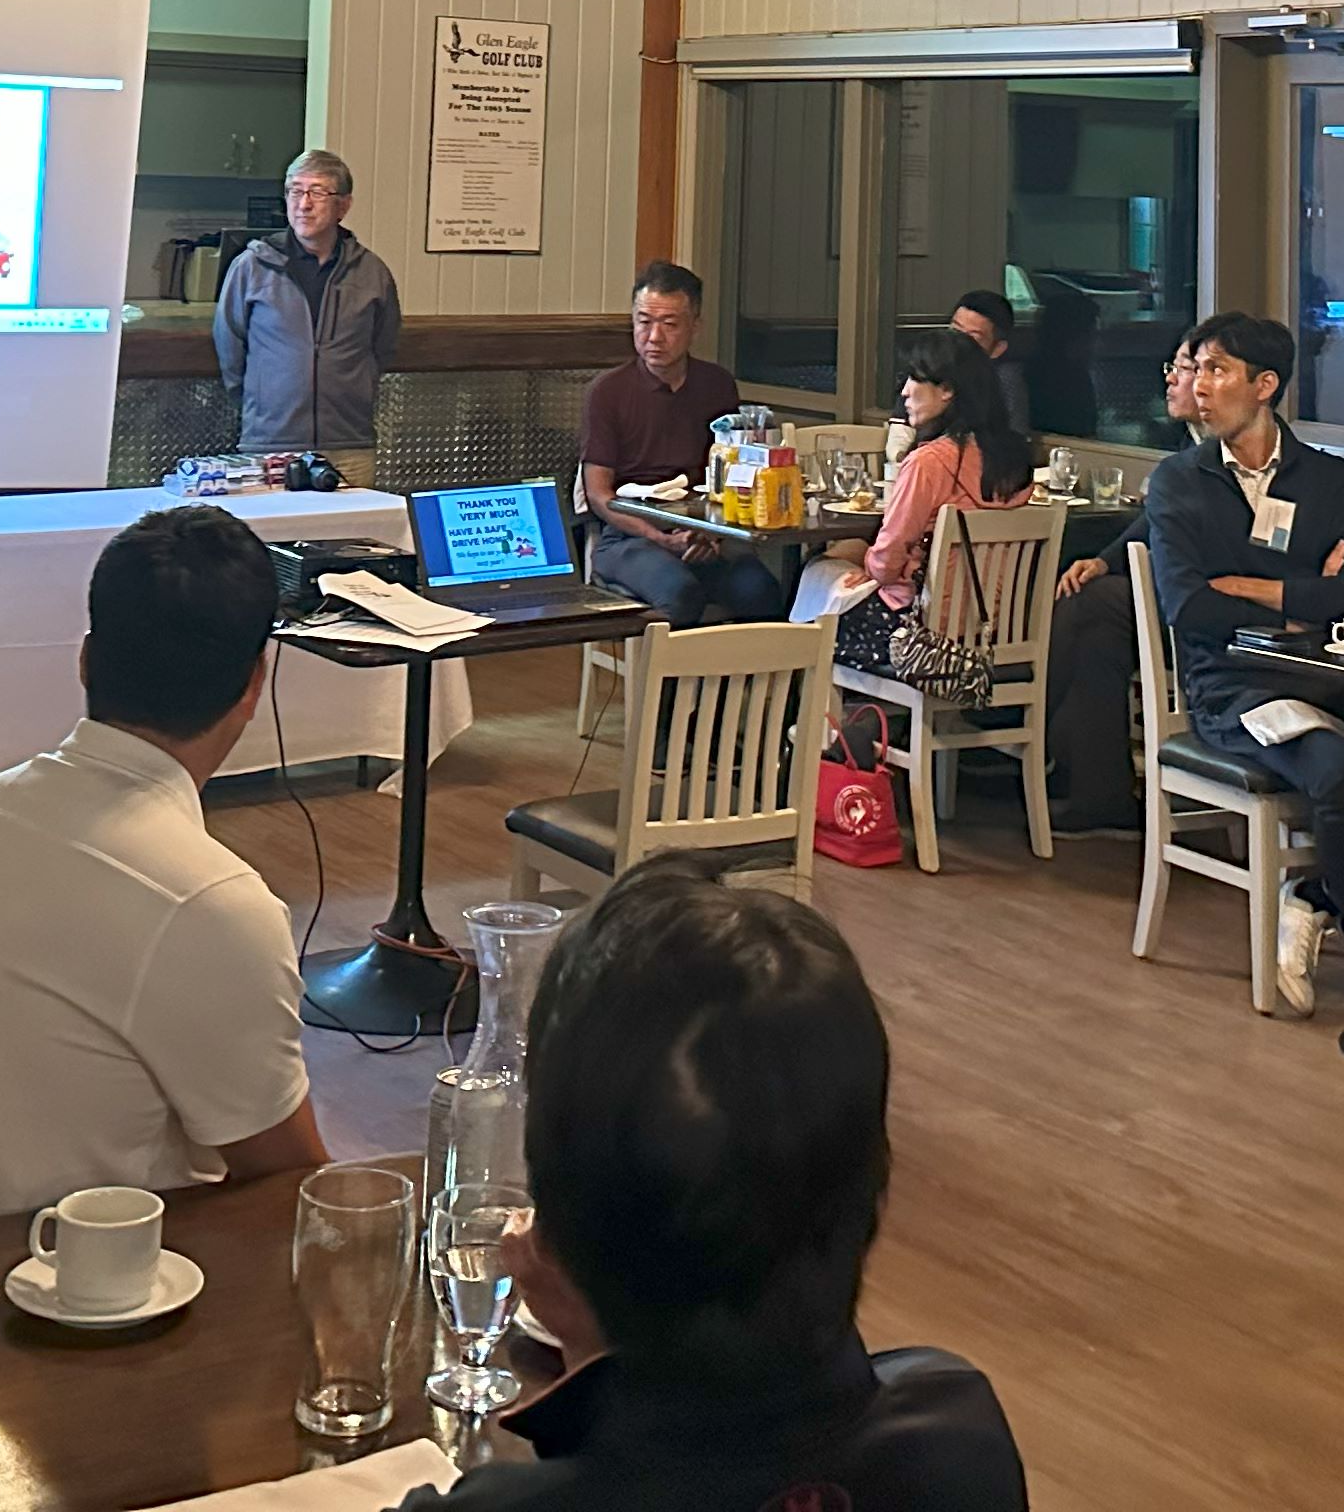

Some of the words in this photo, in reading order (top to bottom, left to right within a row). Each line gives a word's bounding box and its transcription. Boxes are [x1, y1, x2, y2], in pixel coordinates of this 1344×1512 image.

[476, 33, 503, 47] Glen
[506, 35, 538, 50] Eagle
[481, 51, 511, 66] GOLF
[513, 53, 543, 68] CLUB
[456, 499, 493, 509] THANK
[495, 497, 516, 506] YOU
[459, 512, 486, 521] VERY
[489, 509, 519, 518] MUCH
[448, 527, 473, 536] HAVE
[484, 525, 507, 534] SAFE
[451, 538, 480, 547] DRIVE
